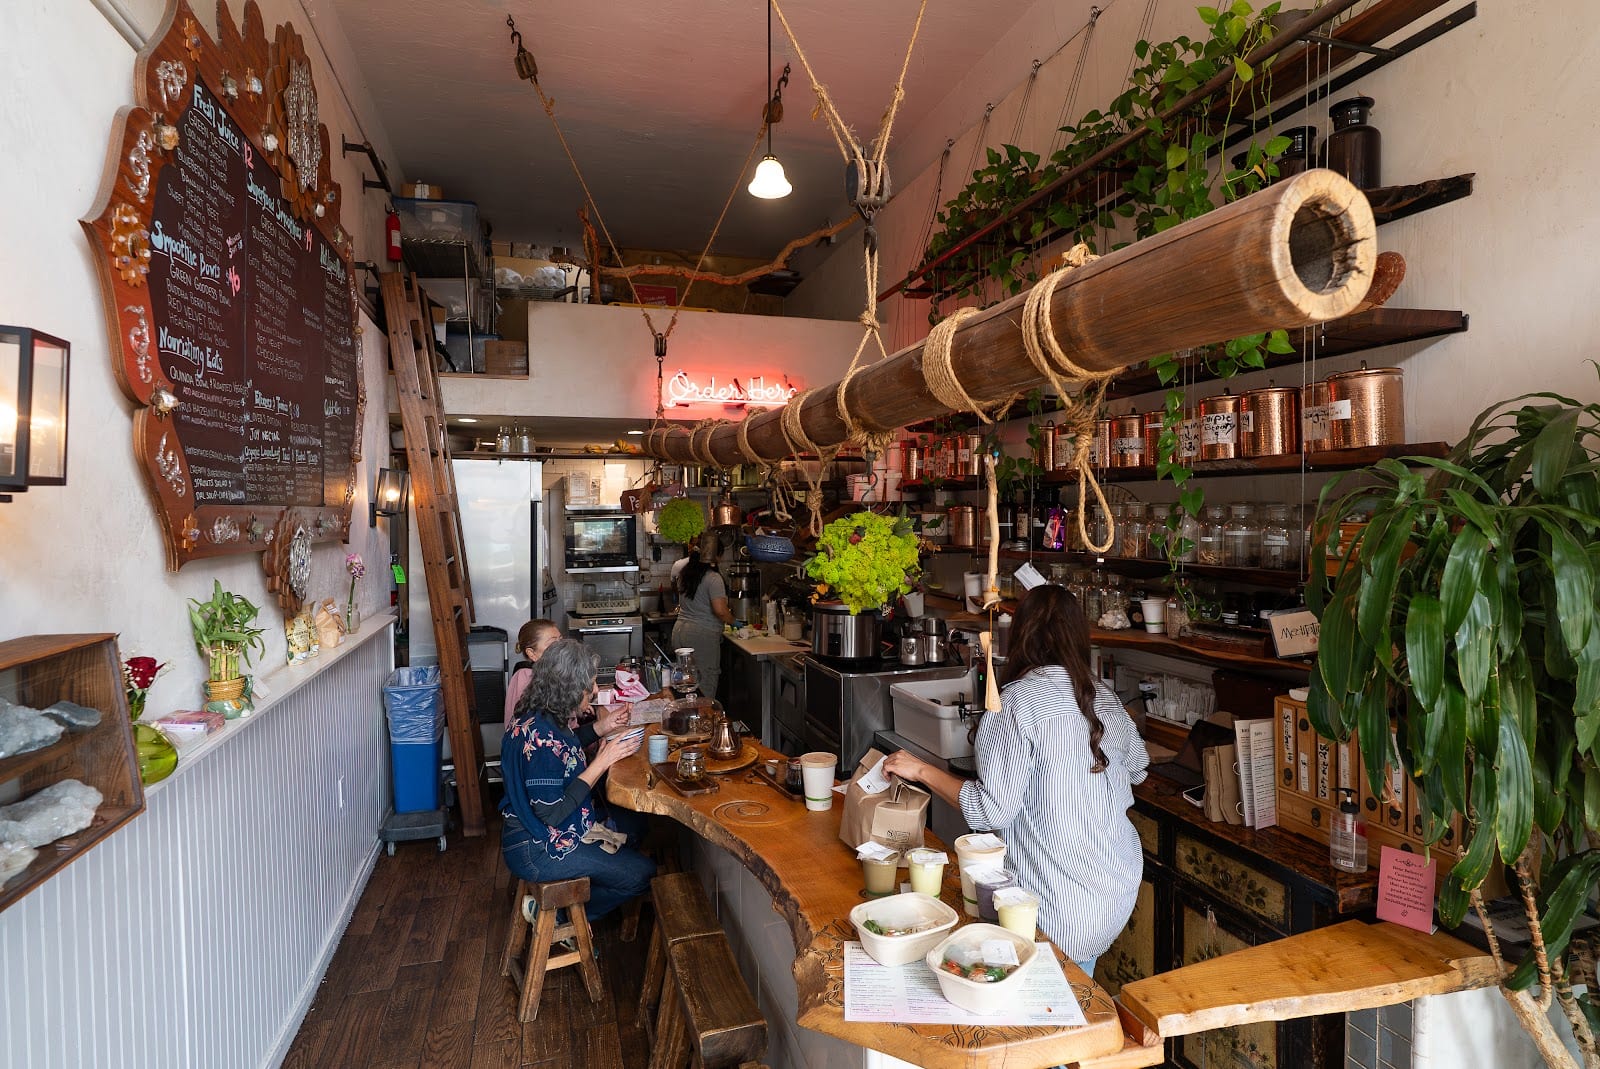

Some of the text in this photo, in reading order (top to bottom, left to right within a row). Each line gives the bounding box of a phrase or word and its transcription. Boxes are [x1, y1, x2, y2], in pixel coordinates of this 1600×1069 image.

[188, 110, 208, 139] GREEN
[193, 84, 216, 128] Fresh
[217, 107, 239, 149] Juice
[151, 220, 197, 266] Smoothie
[169, 262, 191, 286] GREEN
[194, 276, 217, 299] GODDESS
[167, 294, 182, 312] RED
[184, 304, 205, 325] VELVET
[159, 326, 223, 379] Nourishing Eats
[169, 367, 194, 384] QUINOA
[669, 369, 797, 400] Order Here
[249, 428, 260, 441] JOY
